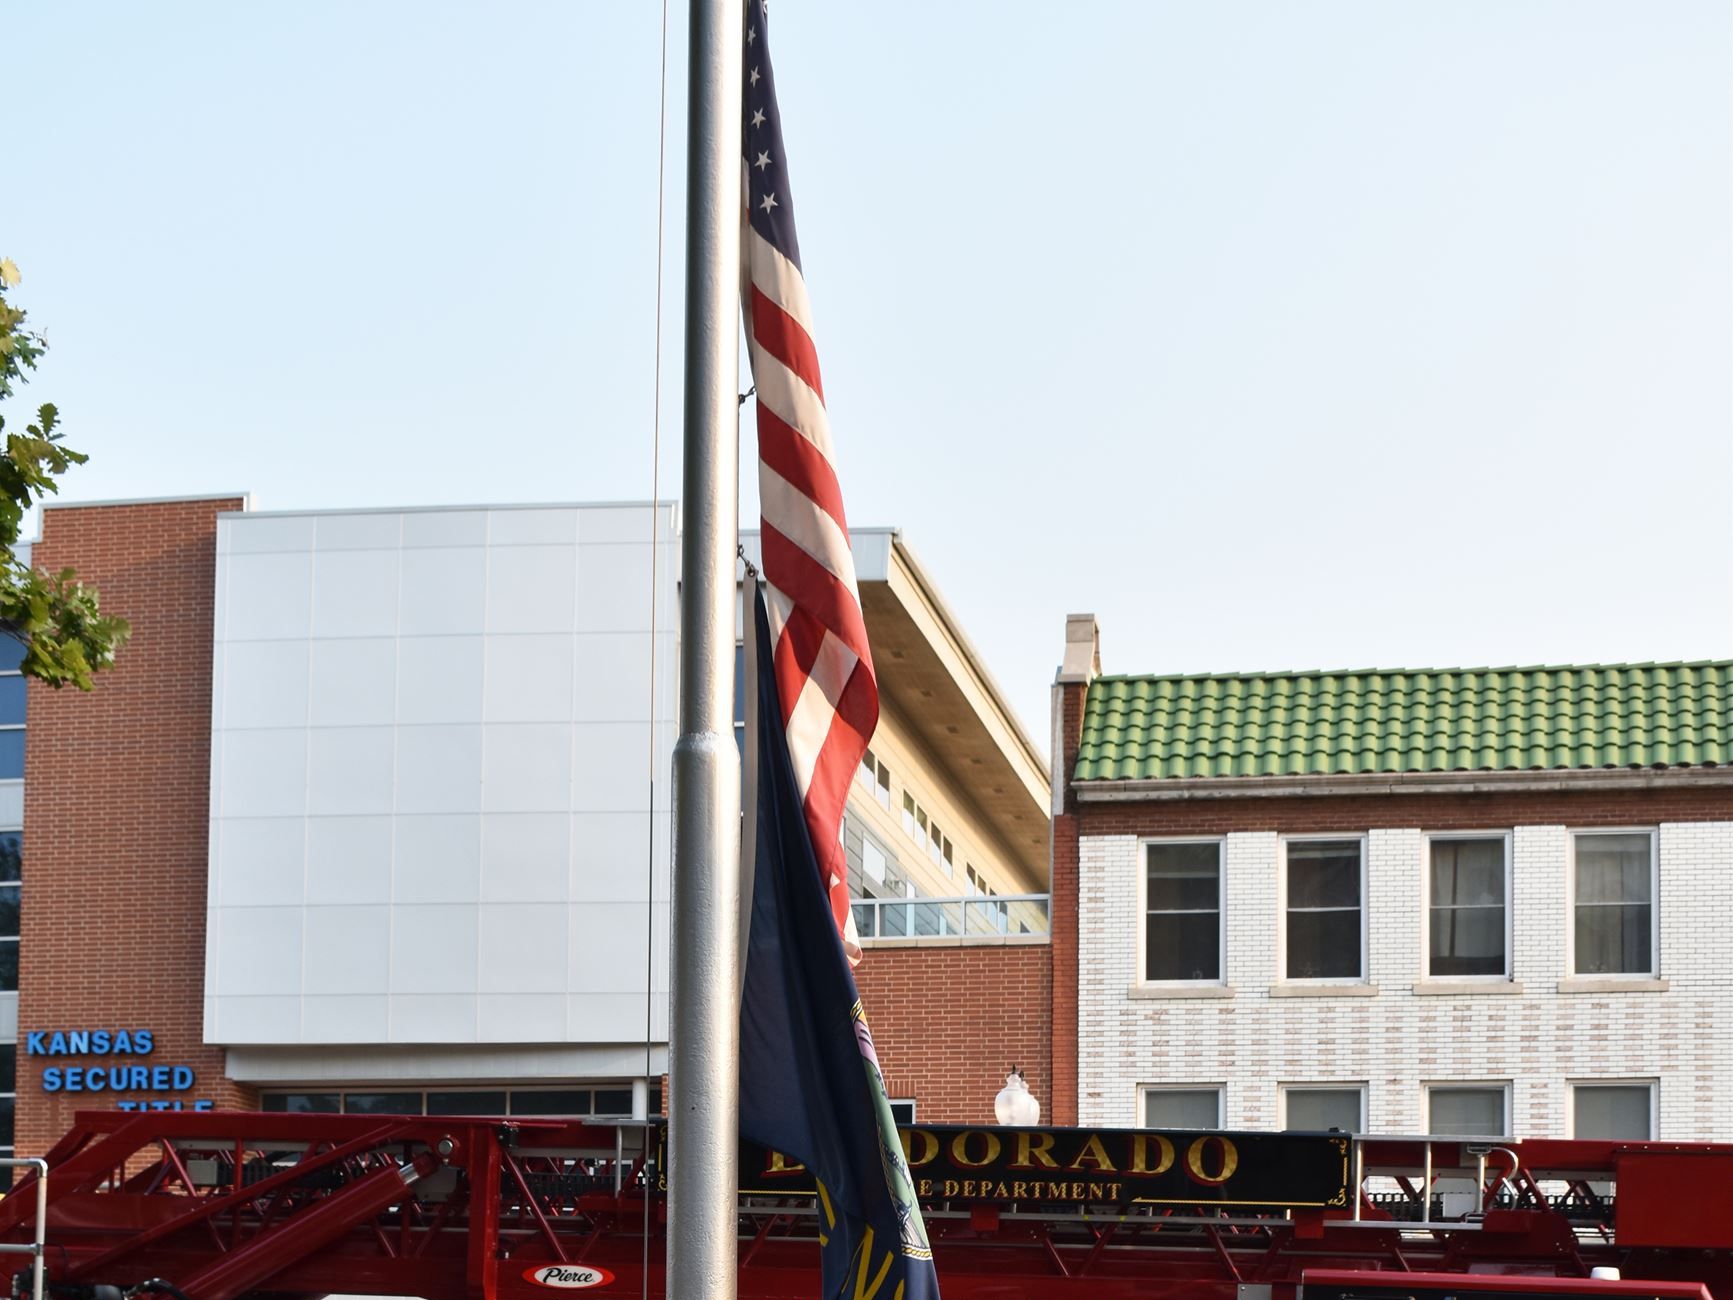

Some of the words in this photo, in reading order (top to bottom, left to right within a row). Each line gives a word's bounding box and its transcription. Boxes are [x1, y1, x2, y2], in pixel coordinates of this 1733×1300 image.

[27, 1030, 153, 1055] KANSAS
[43, 1065, 194, 1091] SECURED
[903, 1129, 1239, 1186] DORADO
[944, 1179, 1122, 1201] DEPARTMENT
[542, 1267, 593, 1284] Pierce
